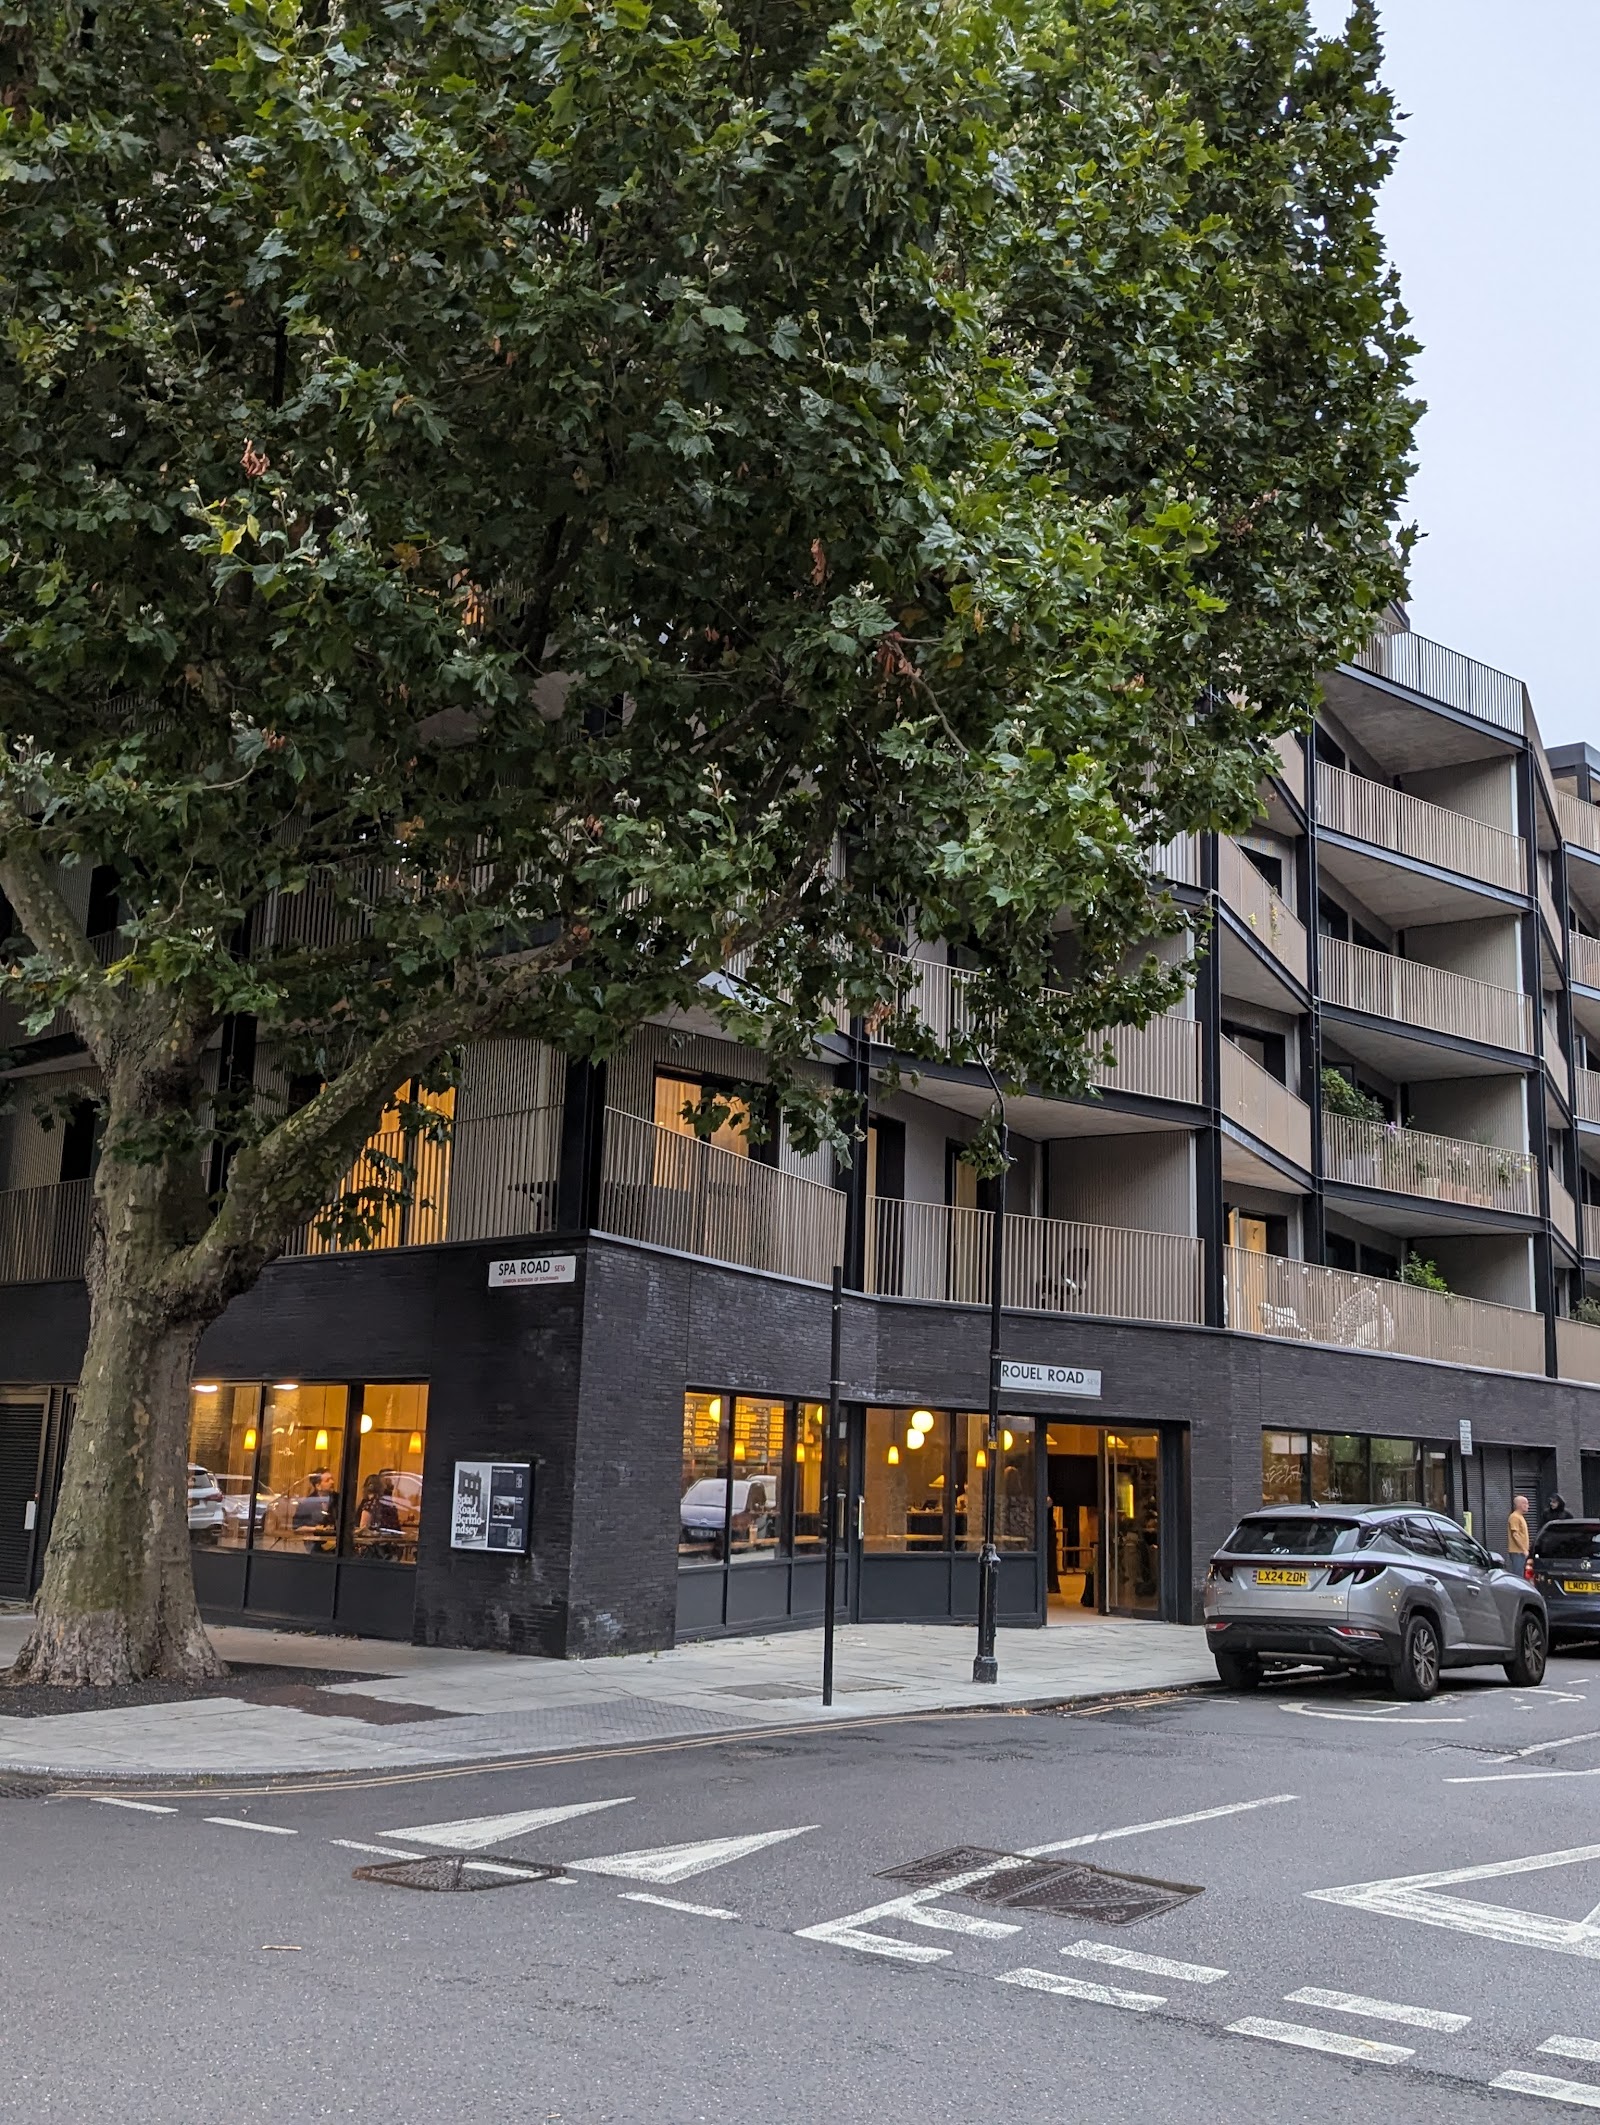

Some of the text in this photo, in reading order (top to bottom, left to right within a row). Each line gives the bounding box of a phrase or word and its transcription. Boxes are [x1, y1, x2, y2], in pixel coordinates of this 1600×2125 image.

[499, 1263, 516, 1276] SPA
[520, 1260, 551, 1275] ROAD
[1002, 1364, 1042, 1380] ROUEL
[1048, 1369, 1084, 1384] ROAD
[1258, 1570, 1283, 1581] LX24
